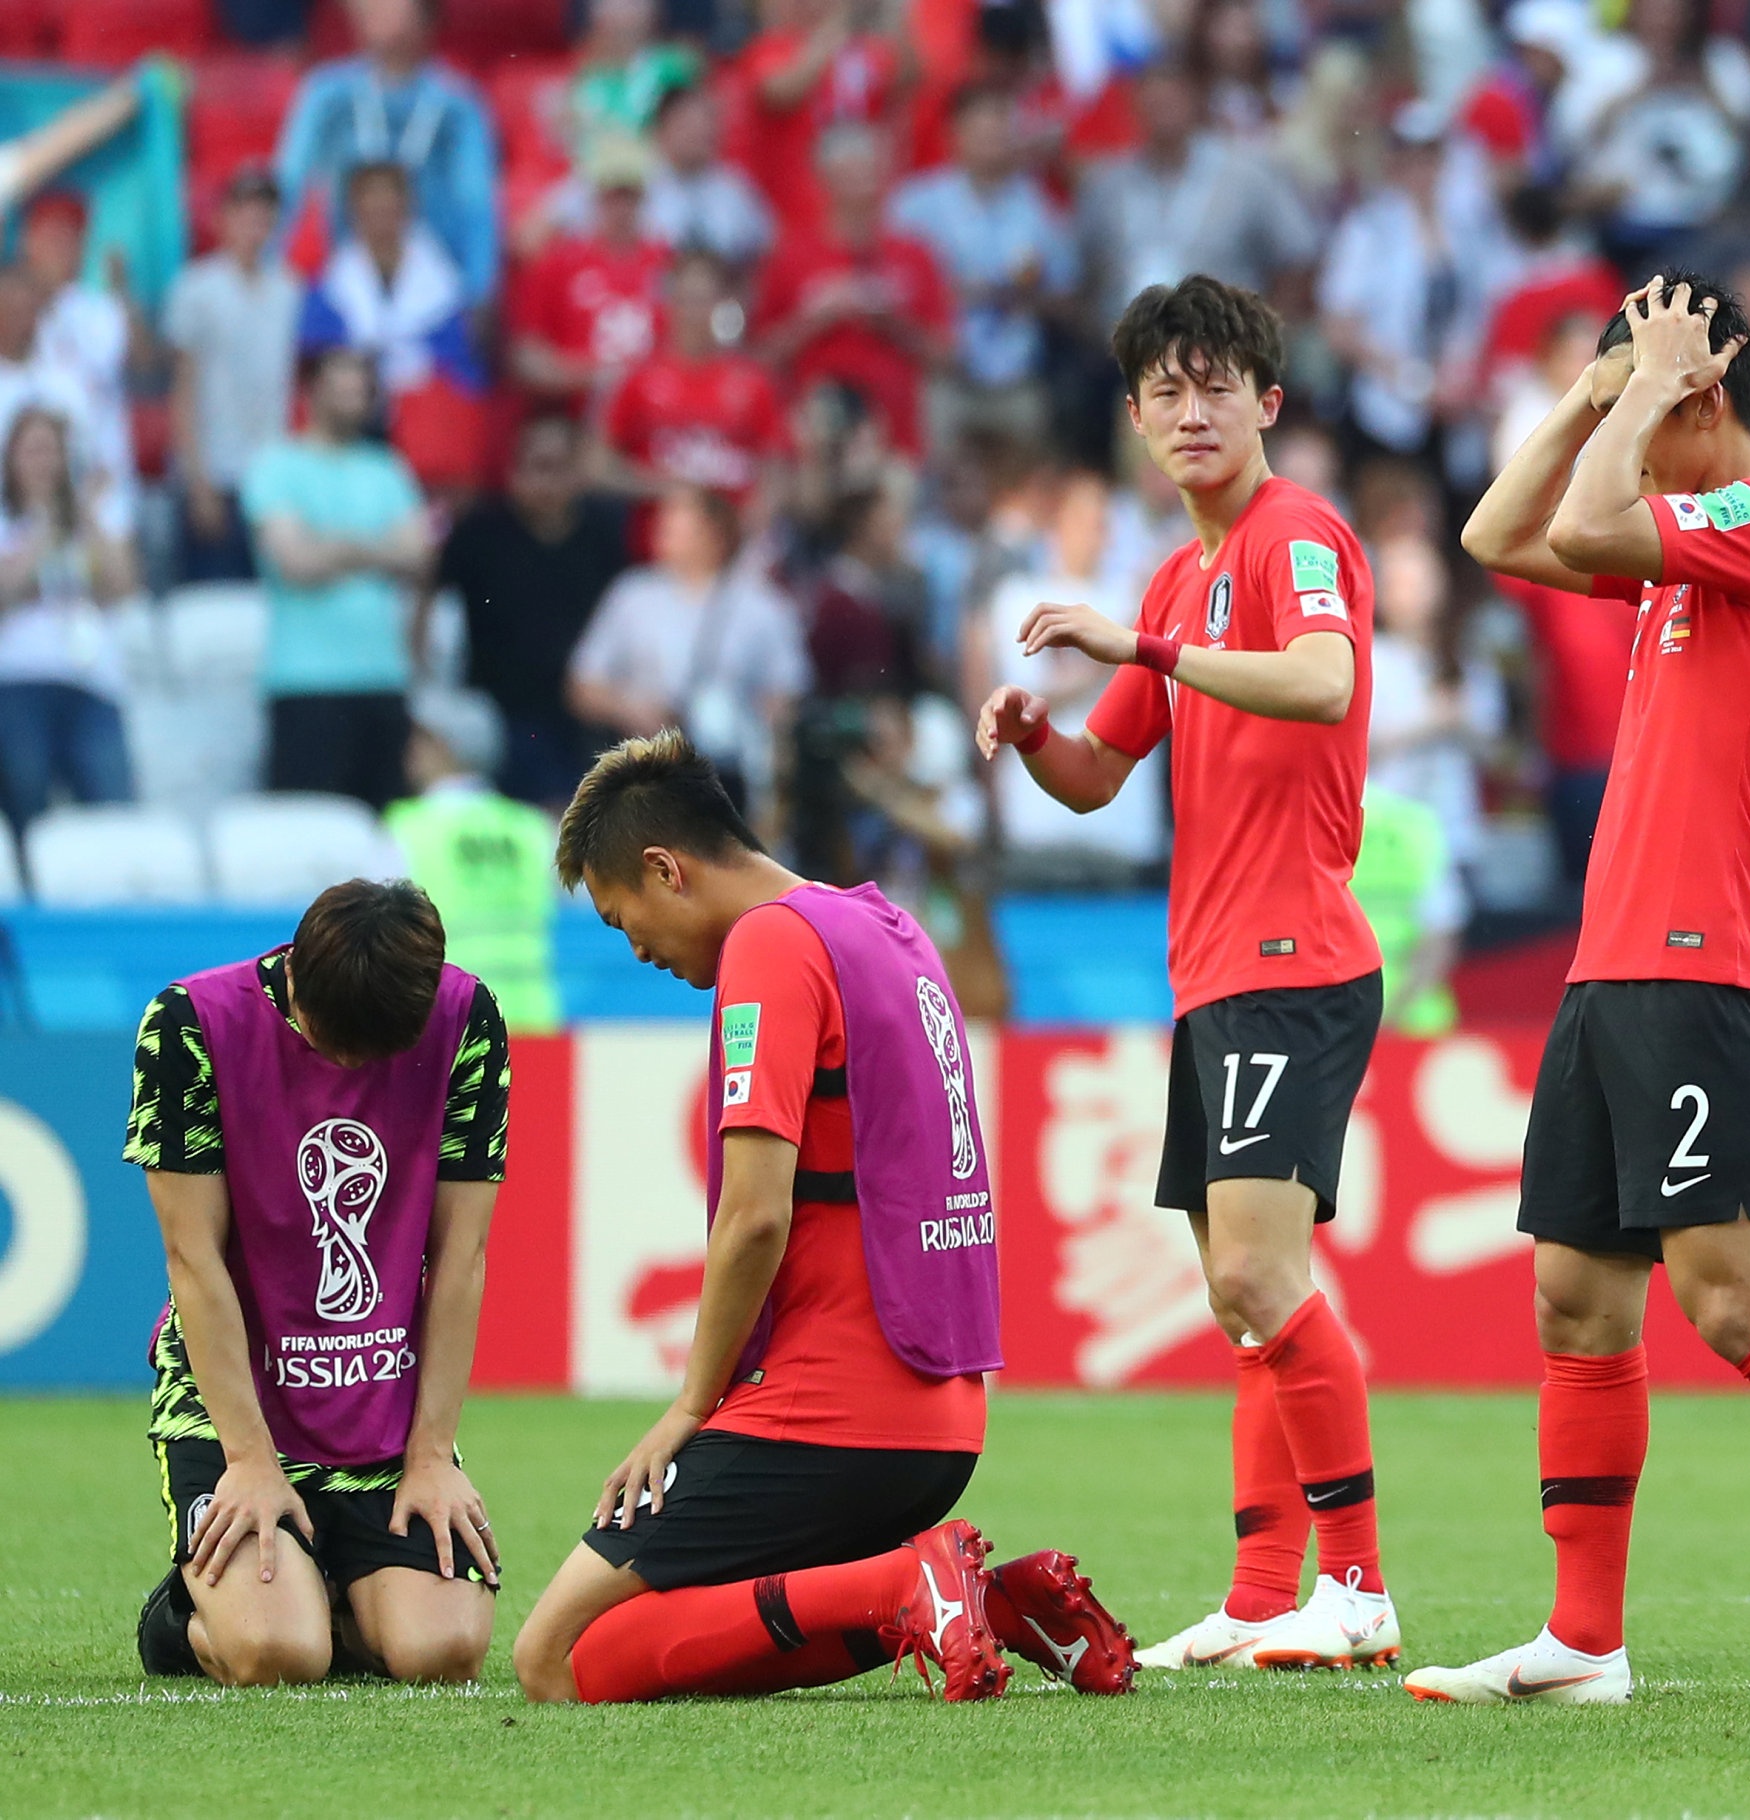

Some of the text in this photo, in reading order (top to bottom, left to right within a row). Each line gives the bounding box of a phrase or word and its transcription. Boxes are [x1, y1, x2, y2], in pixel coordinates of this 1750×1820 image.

[1221, 1052, 1290, 1130] 17
[1668, 1084, 1710, 1168] 2
[979, 1211, 995, 1245] 20
[281, 1327, 407, 1352] FIFA WORLD CUP
